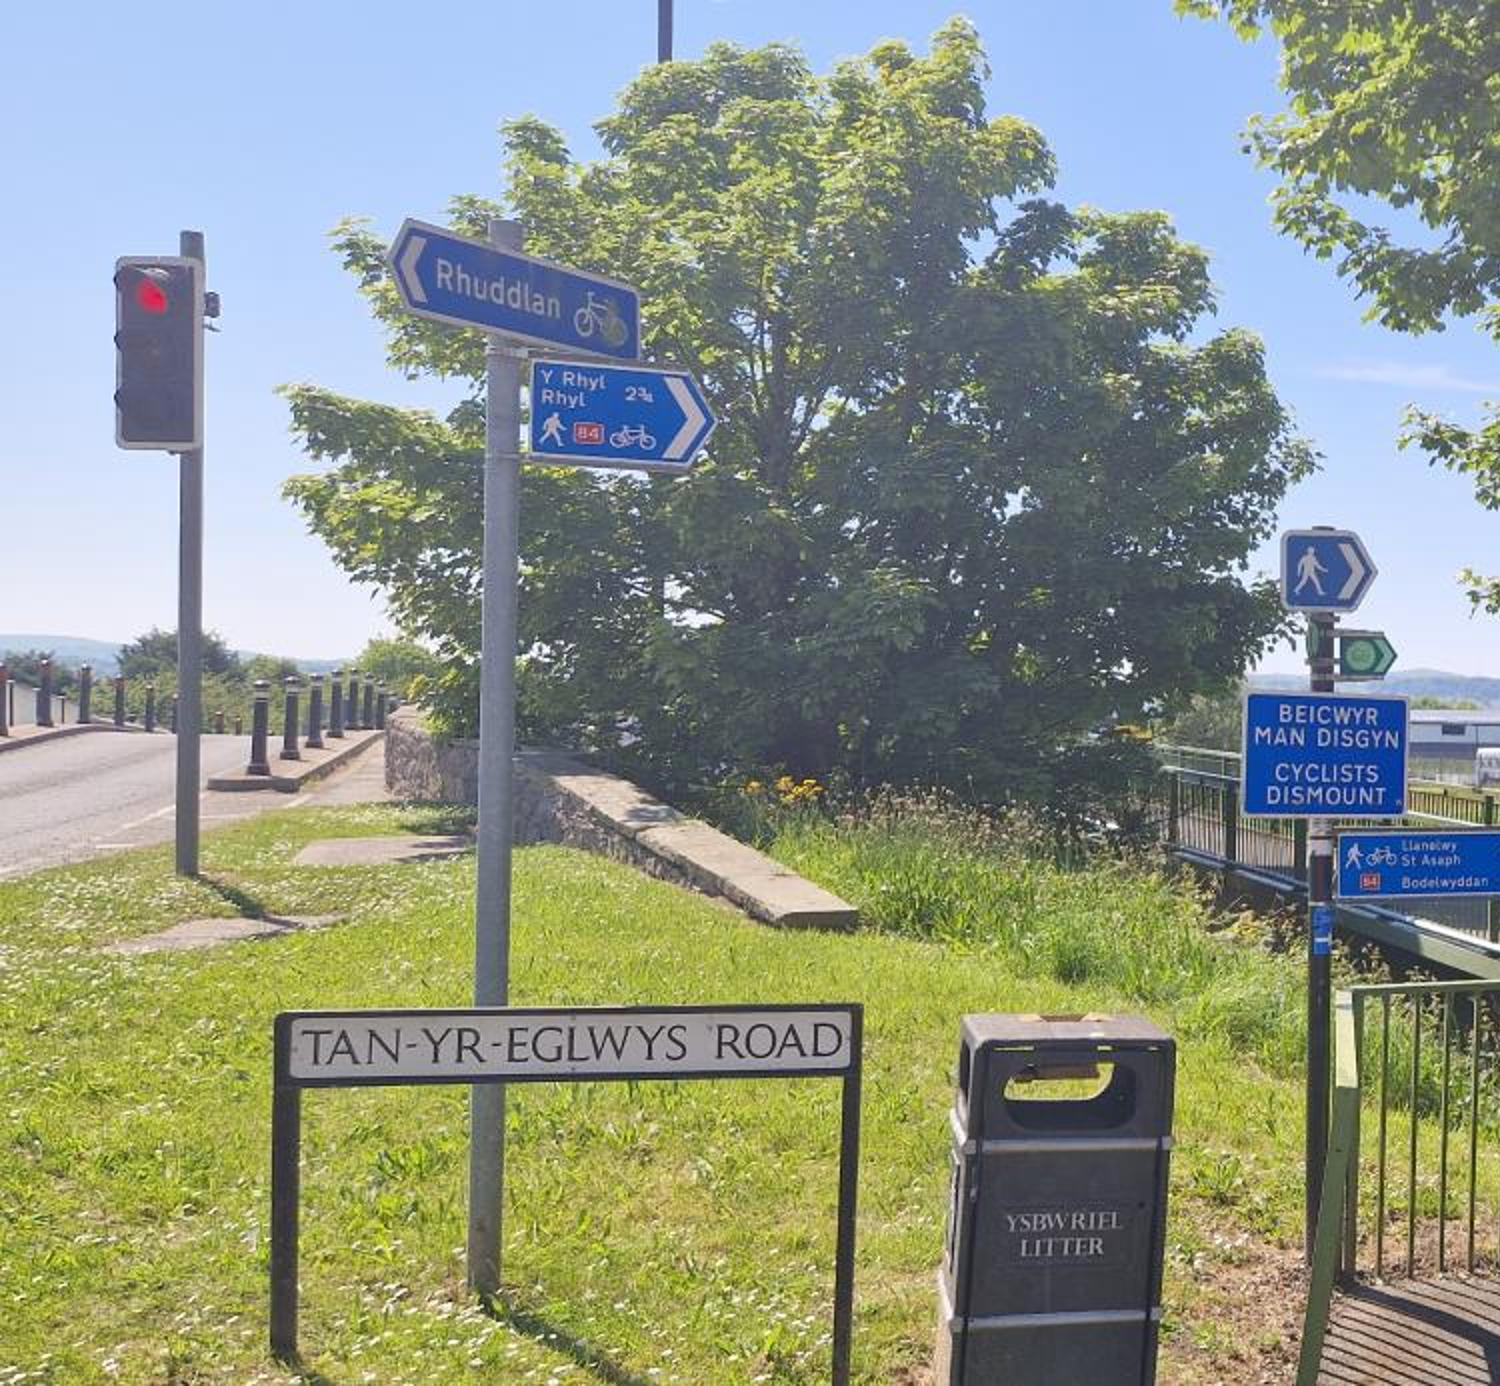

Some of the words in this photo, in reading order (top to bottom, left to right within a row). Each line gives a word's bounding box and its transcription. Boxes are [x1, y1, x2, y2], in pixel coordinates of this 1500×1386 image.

[436, 258, 561, 319] Rhuddlan
[541, 369, 553, 385] Y
[562, 371, 606, 391] Rhyl
[541, 389, 586, 409] Rhyl
[1279, 704, 1378, 726] BEICWYR
[1255, 726, 1305, 746] MAN
[1317, 728, 1399, 748] DISGYN
[1275, 763, 1379, 783] CYCLISTS
[1267, 786, 1387, 805] DISMOUNT
[1402, 840, 1457, 853] Llanelwy
[1402, 856, 1416, 866] St
[1420, 855, 1461, 868] Asaph
[1402, 876, 1489, 889] Bodelwyddan
[302, 1025, 687, 1066] TAN-YR-EGLWYS
[715, 1023, 843, 1060] ROAD
[1007, 1211, 1123, 1232] YSBWRIEL
[1021, 1237, 1104, 1256] LITTER
